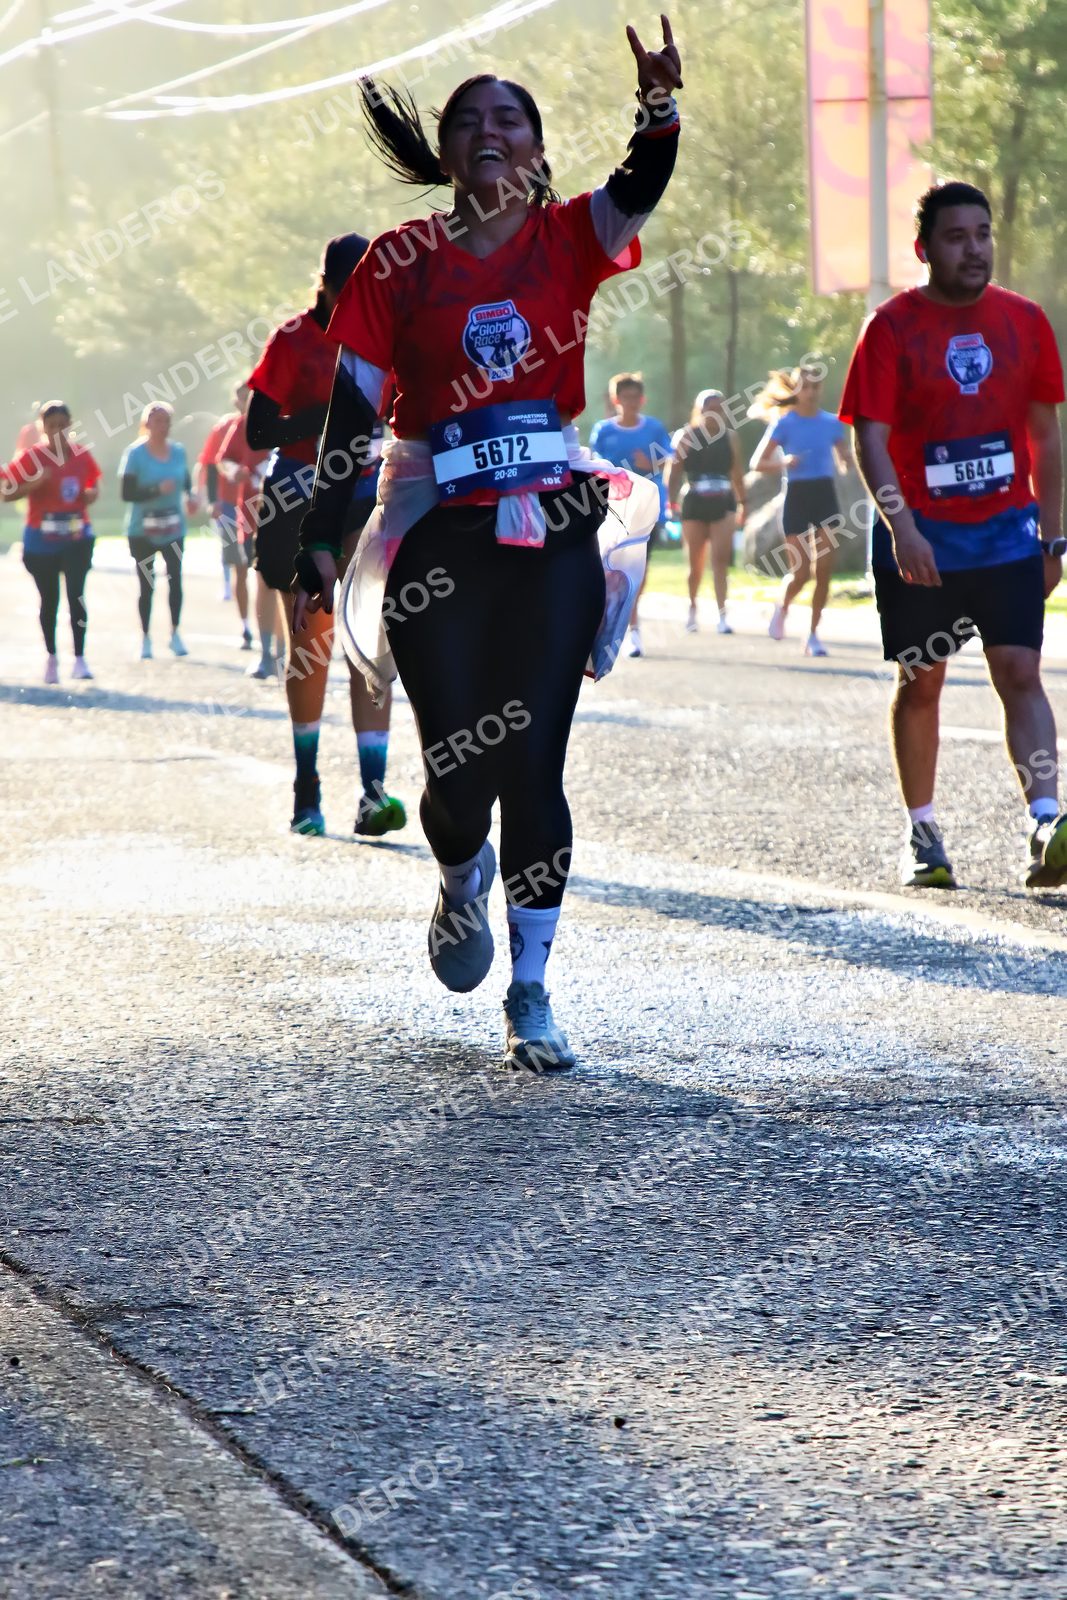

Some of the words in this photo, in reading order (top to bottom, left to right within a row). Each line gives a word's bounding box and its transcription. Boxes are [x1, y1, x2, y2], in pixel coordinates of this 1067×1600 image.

[475, 307, 511, 321] BIMBO
[479, 319, 512, 336] Global
[474, 334, 501, 348] Race
[472, 435, 531, 470] 5672
[954, 458, 994, 482] 5644
[542, 477, 561, 485] 10K
